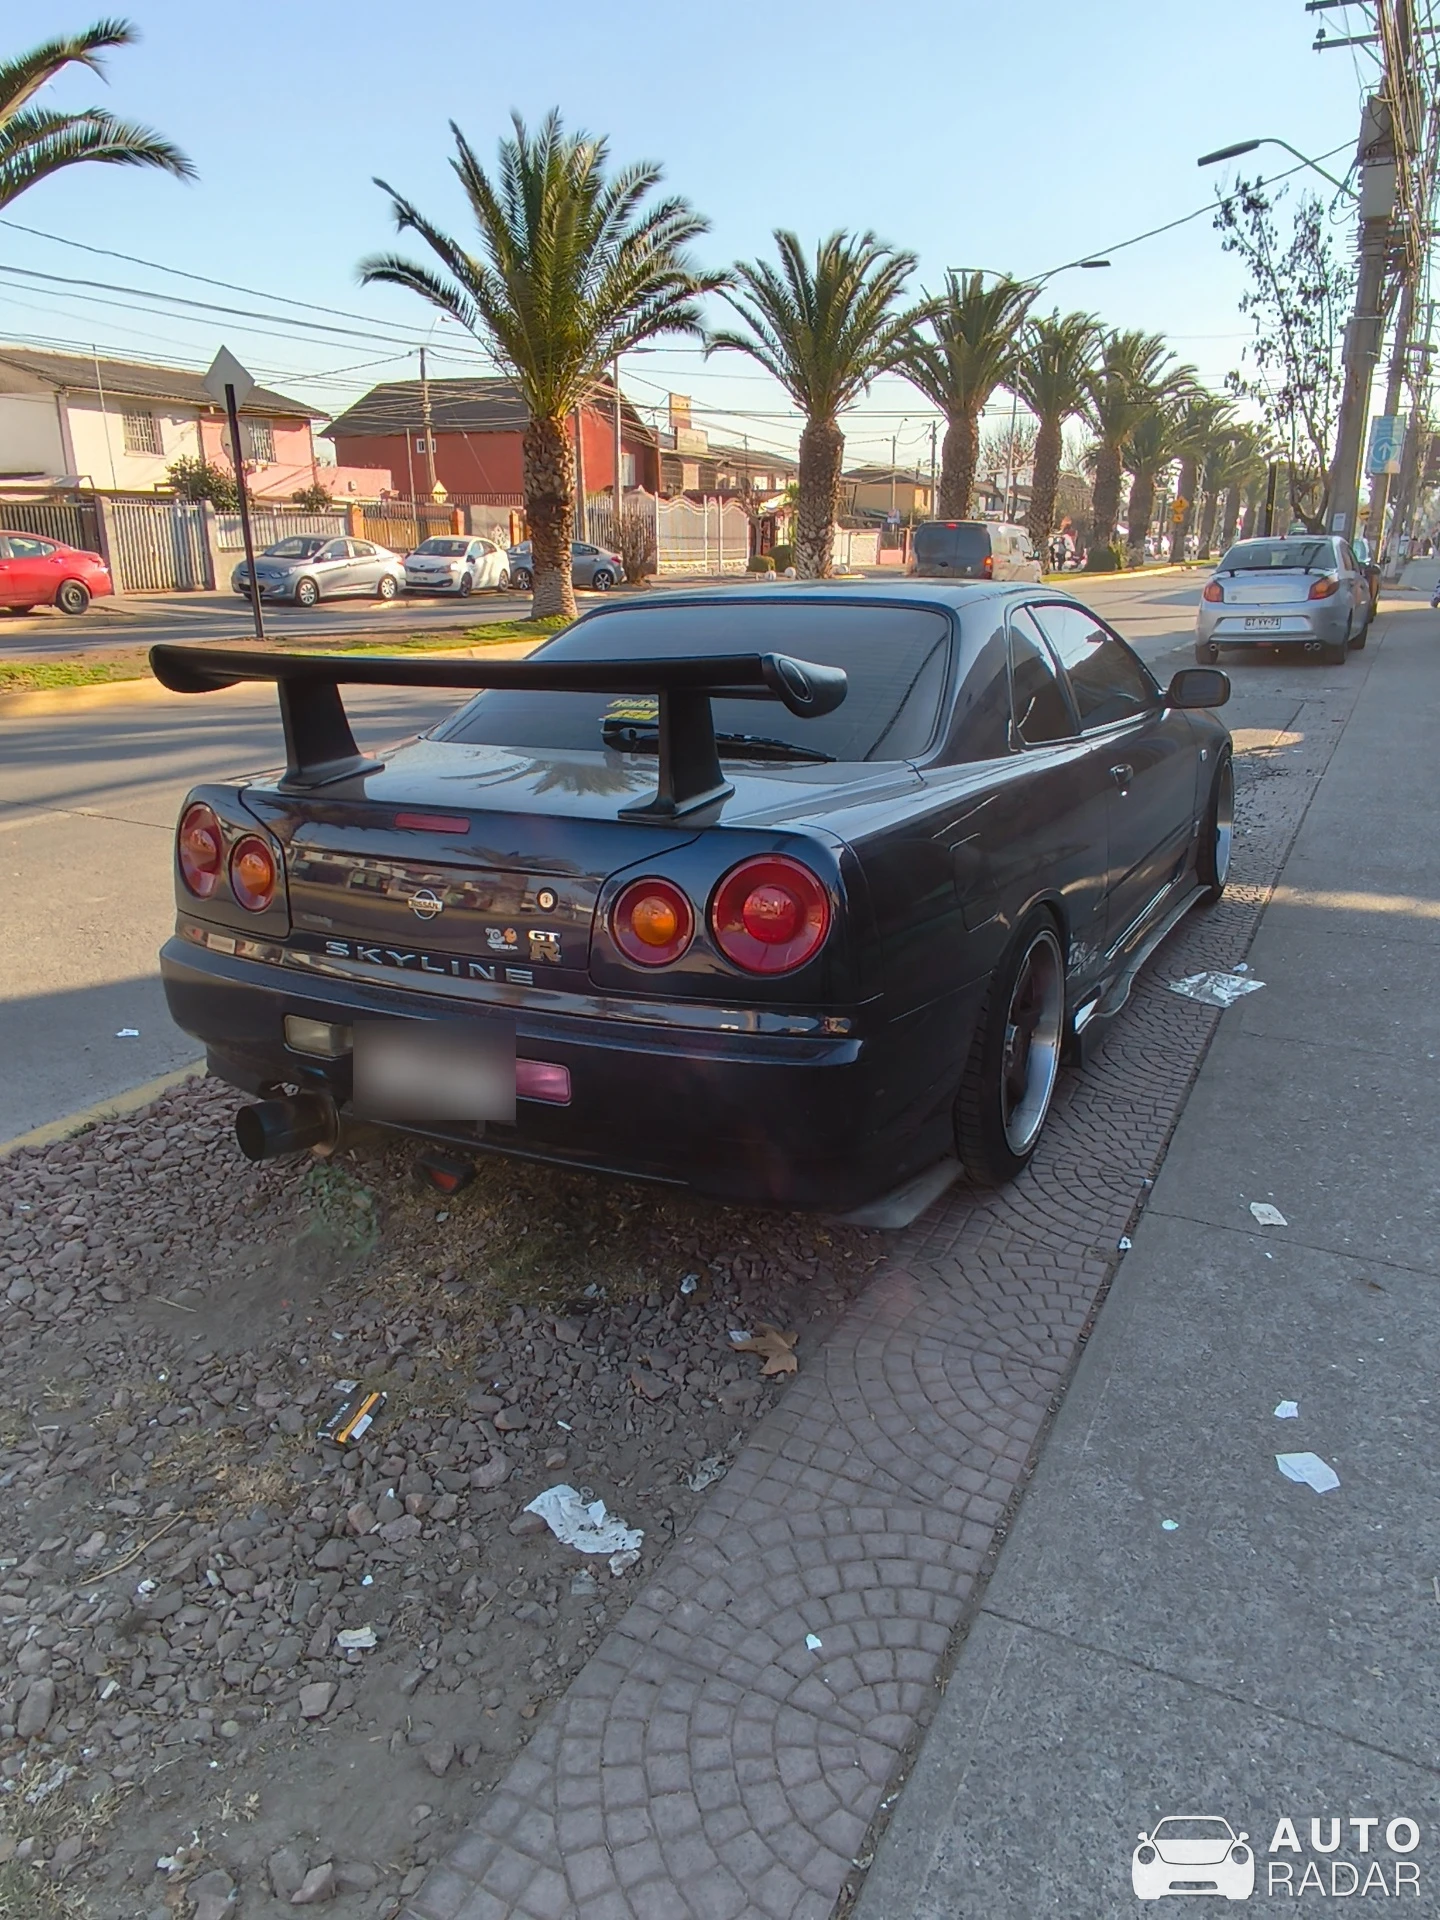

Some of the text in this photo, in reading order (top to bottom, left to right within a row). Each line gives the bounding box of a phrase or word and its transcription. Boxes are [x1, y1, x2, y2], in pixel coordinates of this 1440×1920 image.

[528, 930, 560, 942] GT
[530, 940, 562, 962] R
[325, 940, 534, 986] SKYLINE
